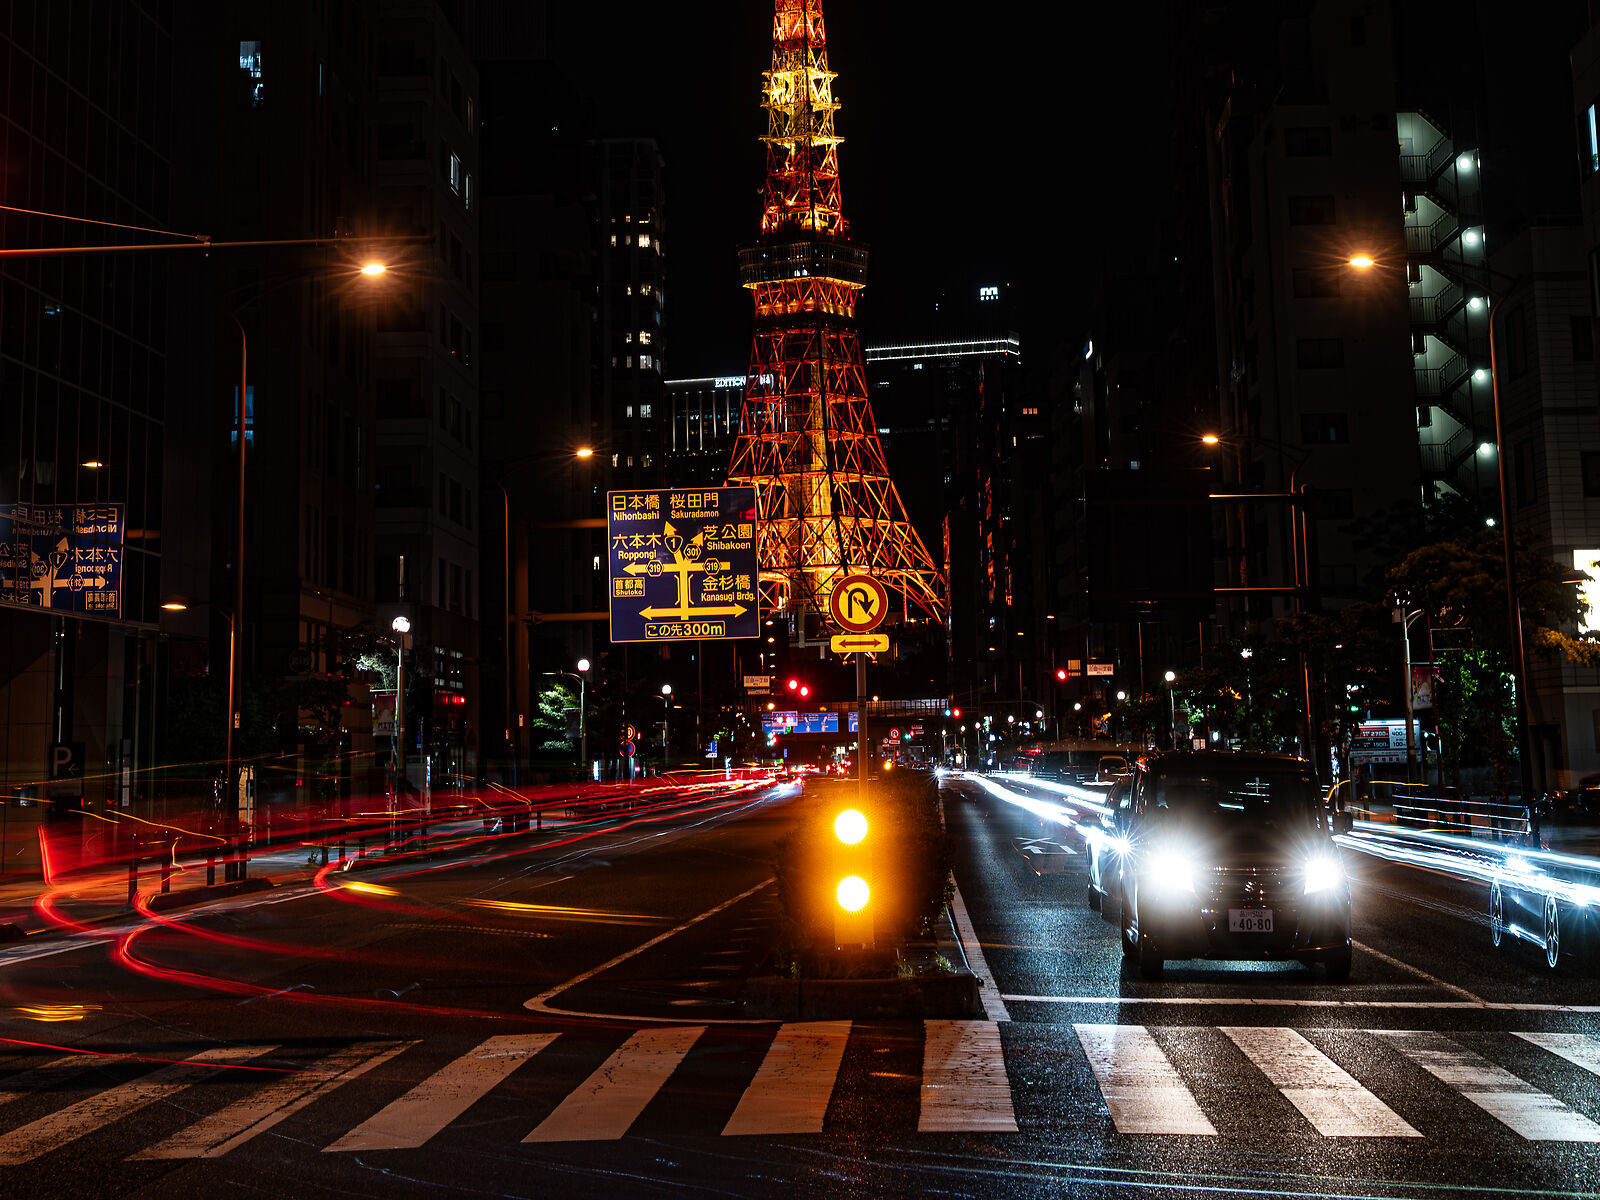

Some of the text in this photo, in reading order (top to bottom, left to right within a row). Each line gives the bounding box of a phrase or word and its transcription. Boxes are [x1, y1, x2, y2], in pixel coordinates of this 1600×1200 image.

[715, 376, 747, 388] EDITION
[613, 493, 719, 510] 日本橋 桜田門
[613, 509, 720, 521] Nihonbashi Sakuradamon
[703, 524, 753, 540] 芝公園
[612, 533, 662, 550] 六本木
[671, 538, 676, 549] 1
[706, 541, 751, 551] Shibakoen
[618, 550, 657, 561] Roppongi
[686, 548, 699, 557] 301
[649, 563, 661, 573] 319
[706, 562, 719, 571] 319
[615, 579, 643, 590] 首都高
[703, 575, 751, 591] 金杉橋
[701, 591, 756, 602] Kanasugi Brdg.
[52, 745, 72, 777] P
[1239, 918, 1271, 931] 40-80
